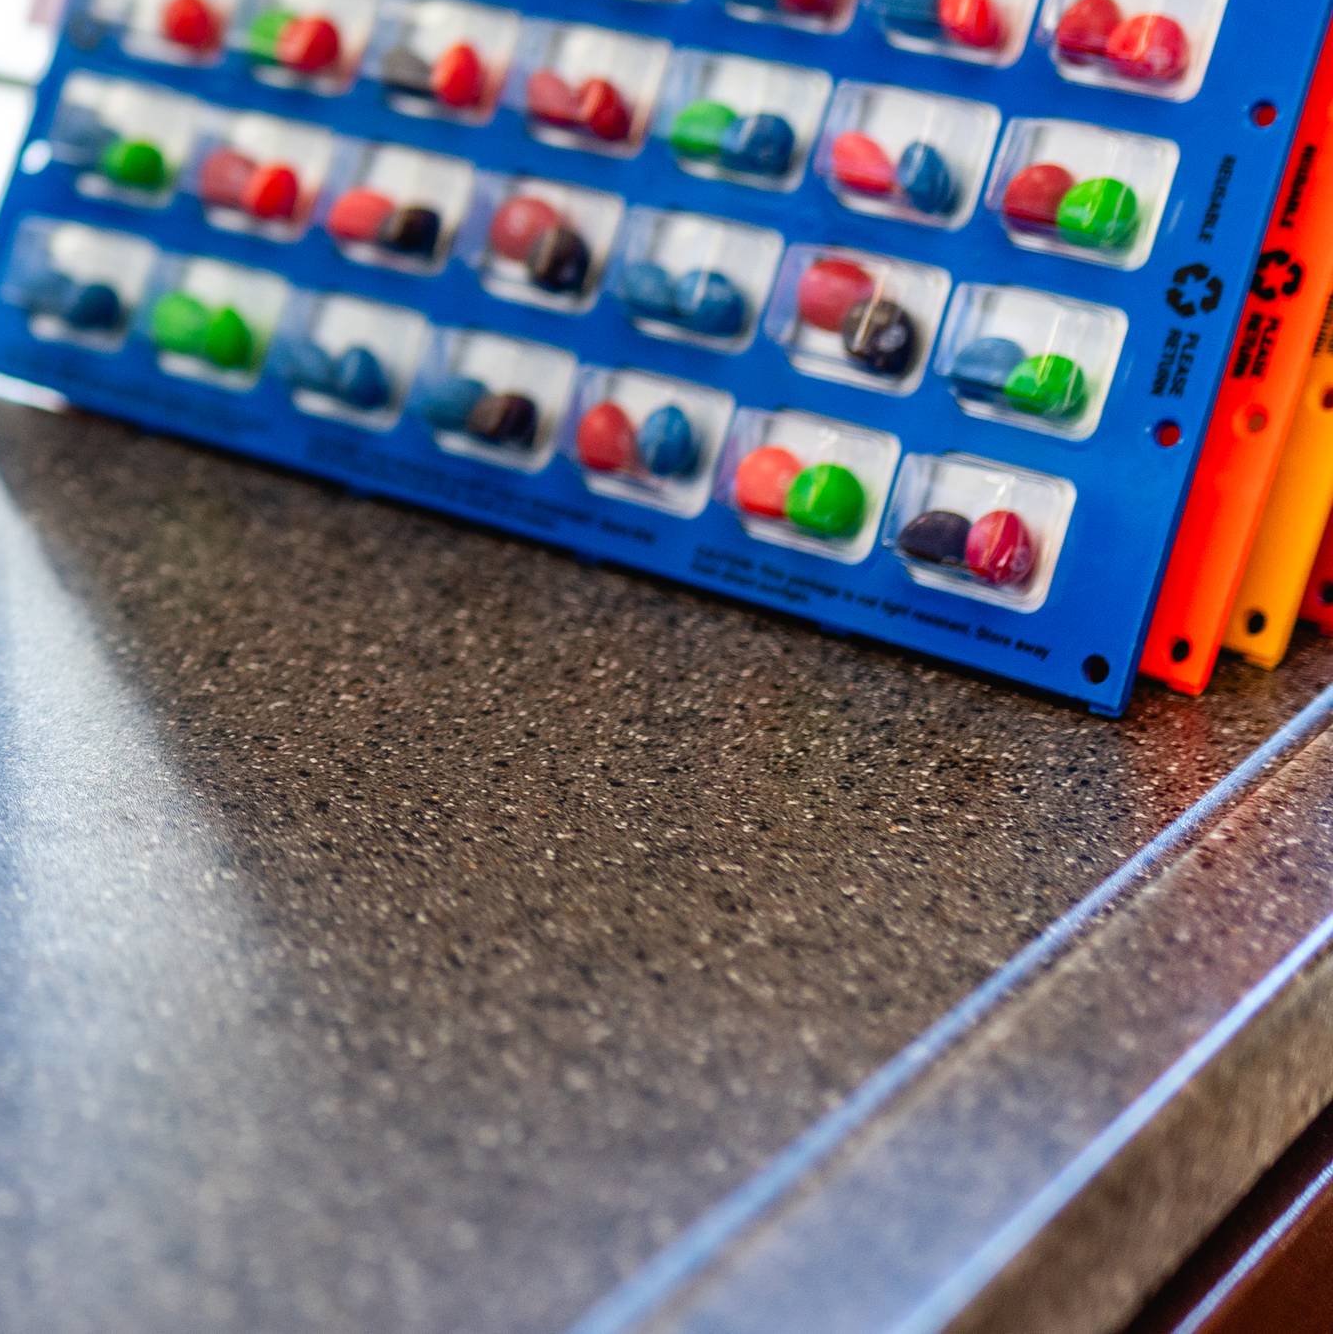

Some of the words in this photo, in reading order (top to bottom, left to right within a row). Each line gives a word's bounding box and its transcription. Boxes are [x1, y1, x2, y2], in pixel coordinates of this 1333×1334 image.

[1152, 328, 1182, 396] RETURN
[1169, 333, 1200, 397] PLEASE
[1251, 317, 1279, 378] PLEASE
